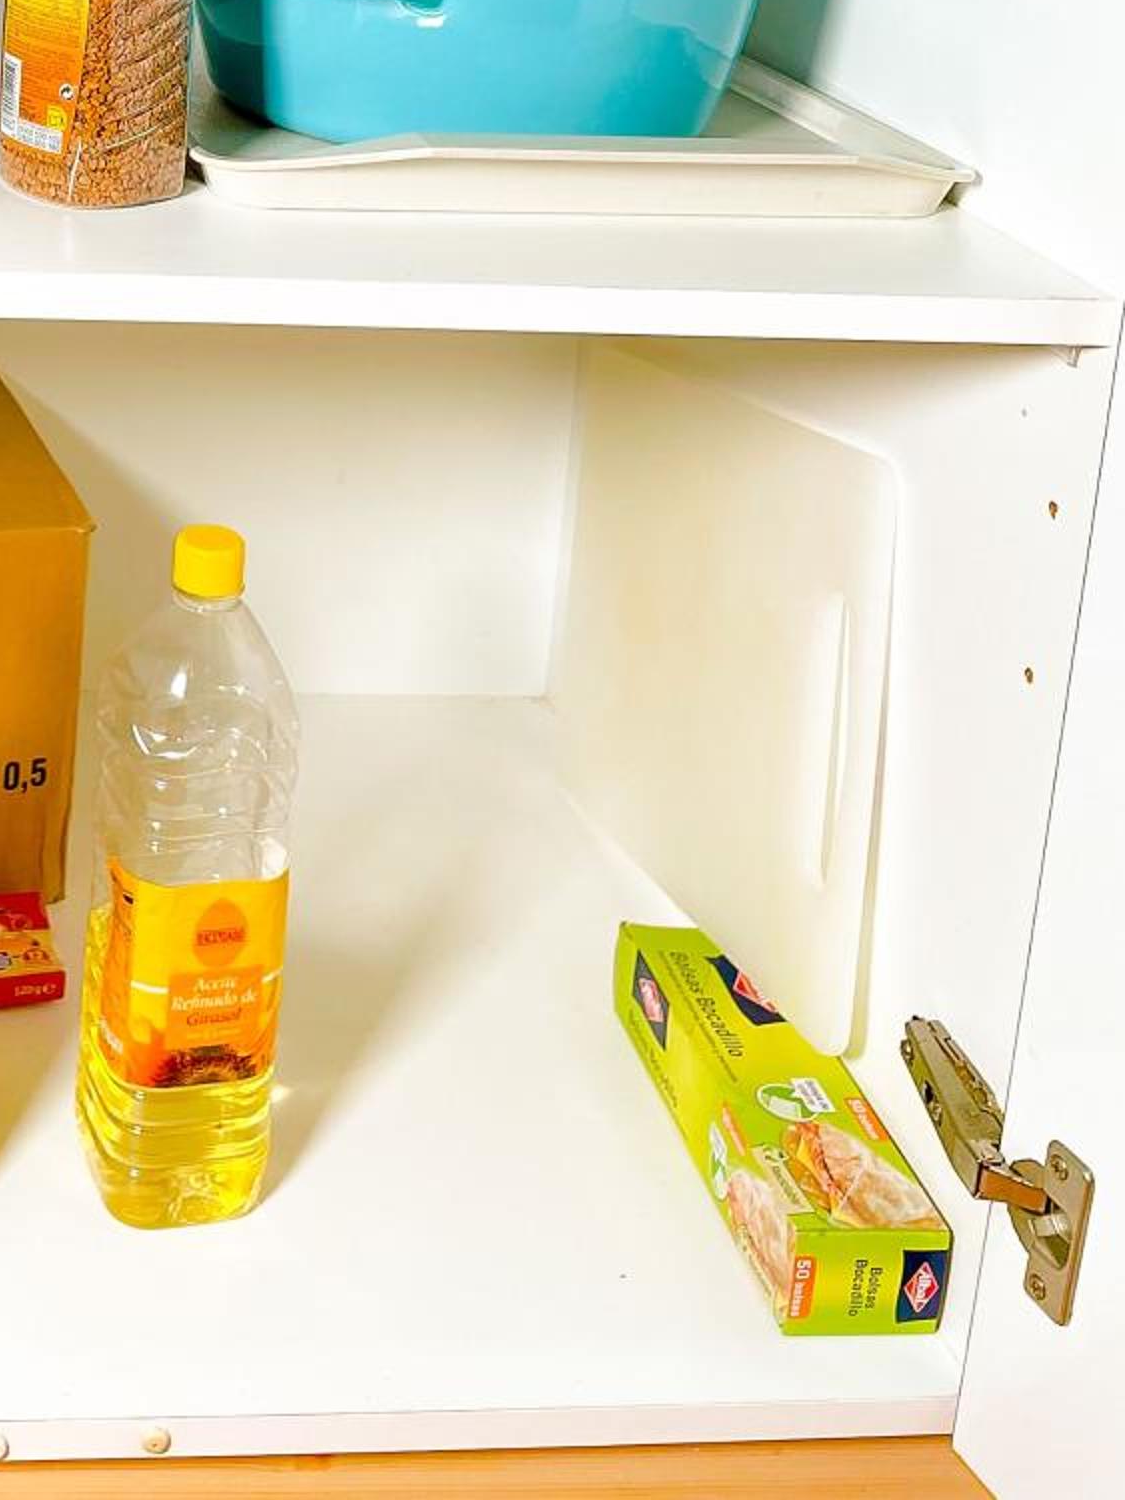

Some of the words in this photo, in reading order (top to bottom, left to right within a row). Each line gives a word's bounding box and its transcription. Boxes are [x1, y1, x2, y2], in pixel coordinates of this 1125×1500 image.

[2, 758, 48, 794] 0,5
[696, 997, 744, 1057] Bocadillo
[795, 1259, 812, 1279] 50
[848, 1259, 868, 1317] Bocadillo
[864, 1266, 884, 1309] Bolsas
